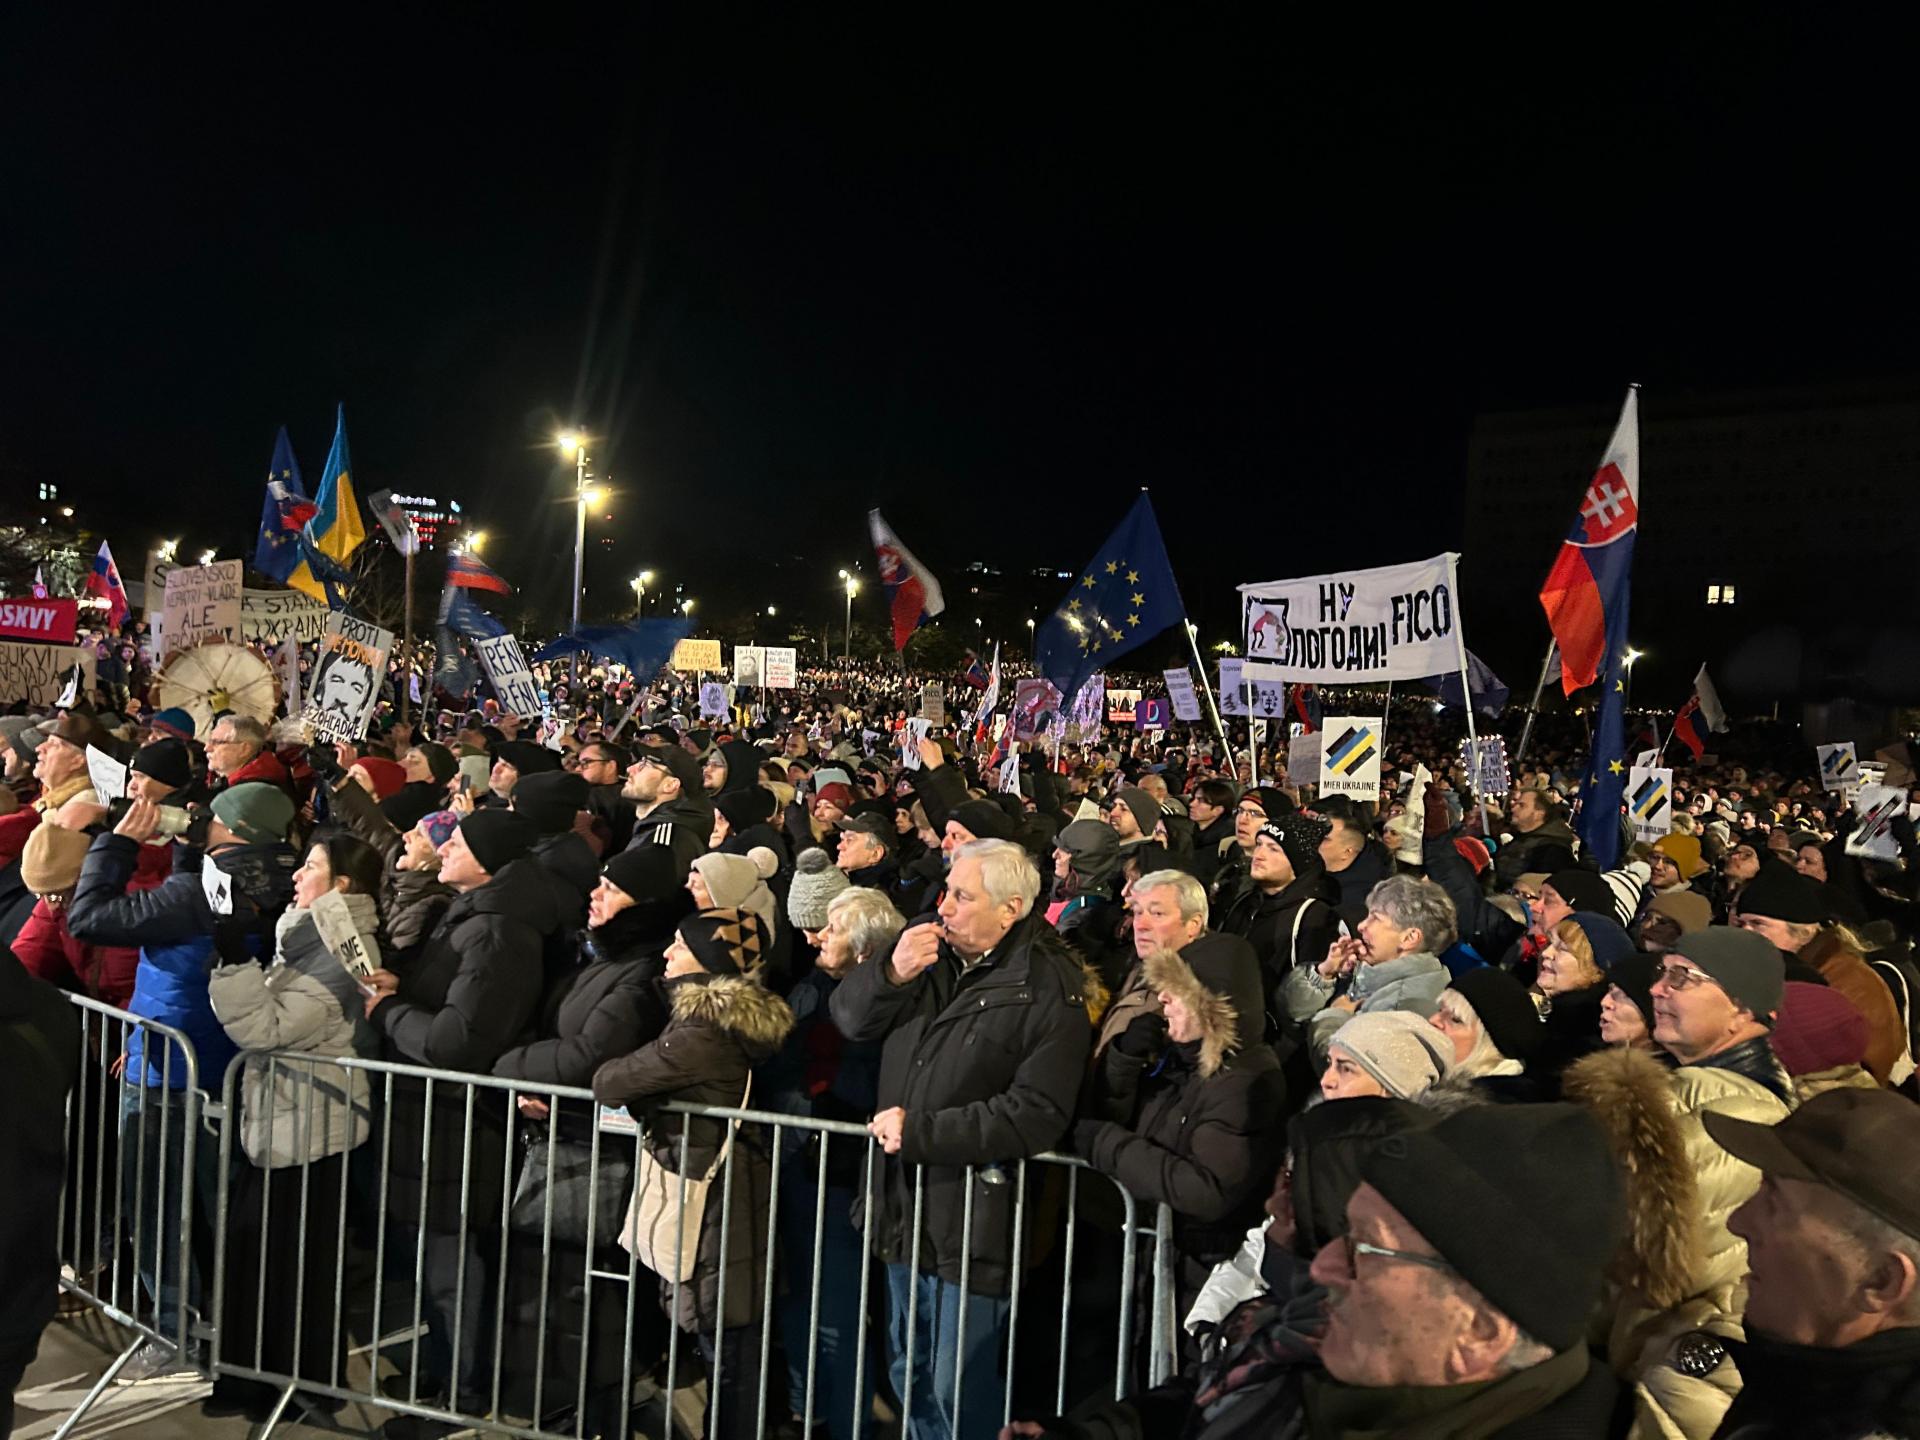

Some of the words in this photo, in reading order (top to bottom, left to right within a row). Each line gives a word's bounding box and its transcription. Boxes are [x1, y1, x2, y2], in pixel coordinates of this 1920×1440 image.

[181, 605, 216, 629] ALE
[1391, 584, 1451, 645] FICO
[339, 616, 380, 647] PROTI
[1291, 623, 1387, 671] ПОГОДИ!
[1323, 780, 1340, 790] MIER
[1342, 781, 1377, 791] UKRAJINE
